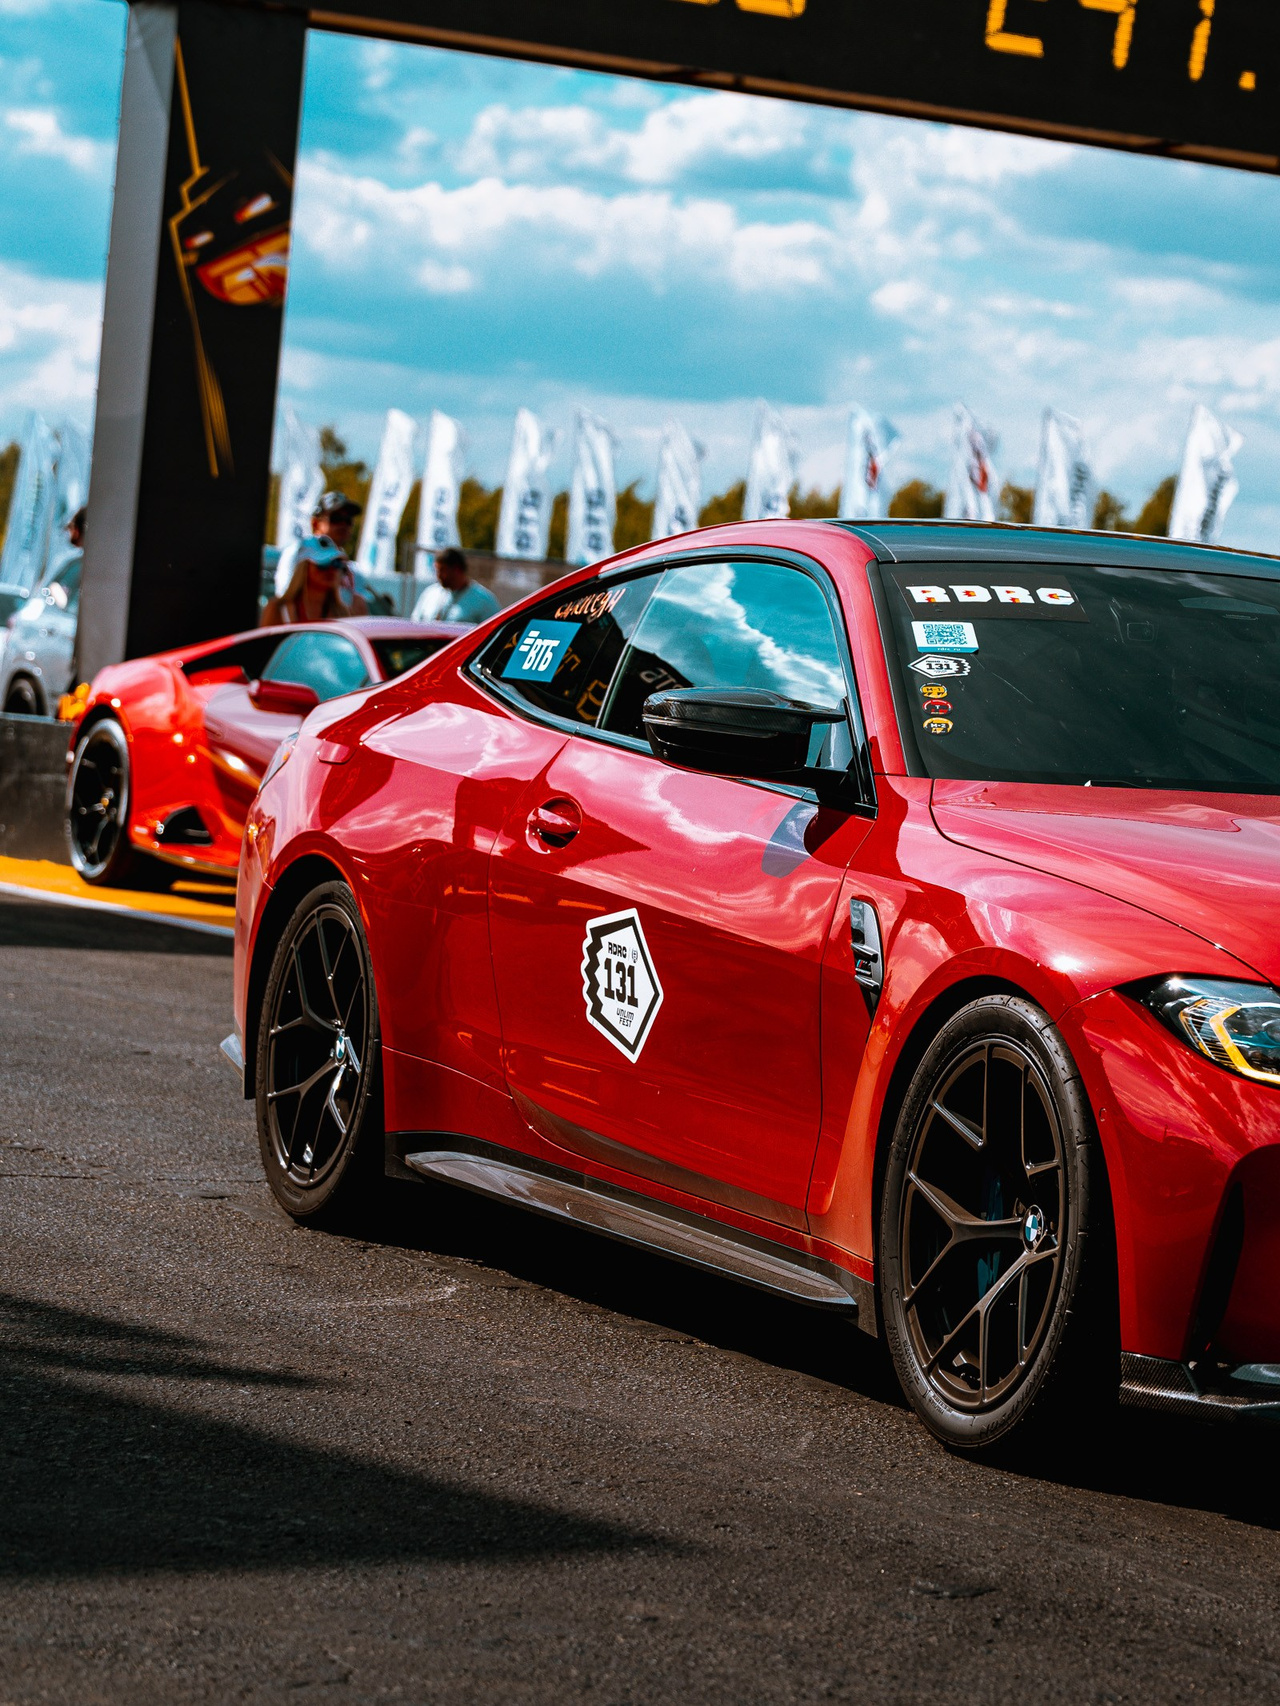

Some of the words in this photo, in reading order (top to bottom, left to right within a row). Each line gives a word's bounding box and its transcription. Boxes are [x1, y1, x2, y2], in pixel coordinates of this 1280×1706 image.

[905, 585, 1075, 606] RDRC
[522, 638, 560, 672] ВТБ
[607, 942, 627, 959] RDRC
[603, 957, 639, 1008] 131
[619, 1016, 632, 1028] FEST
